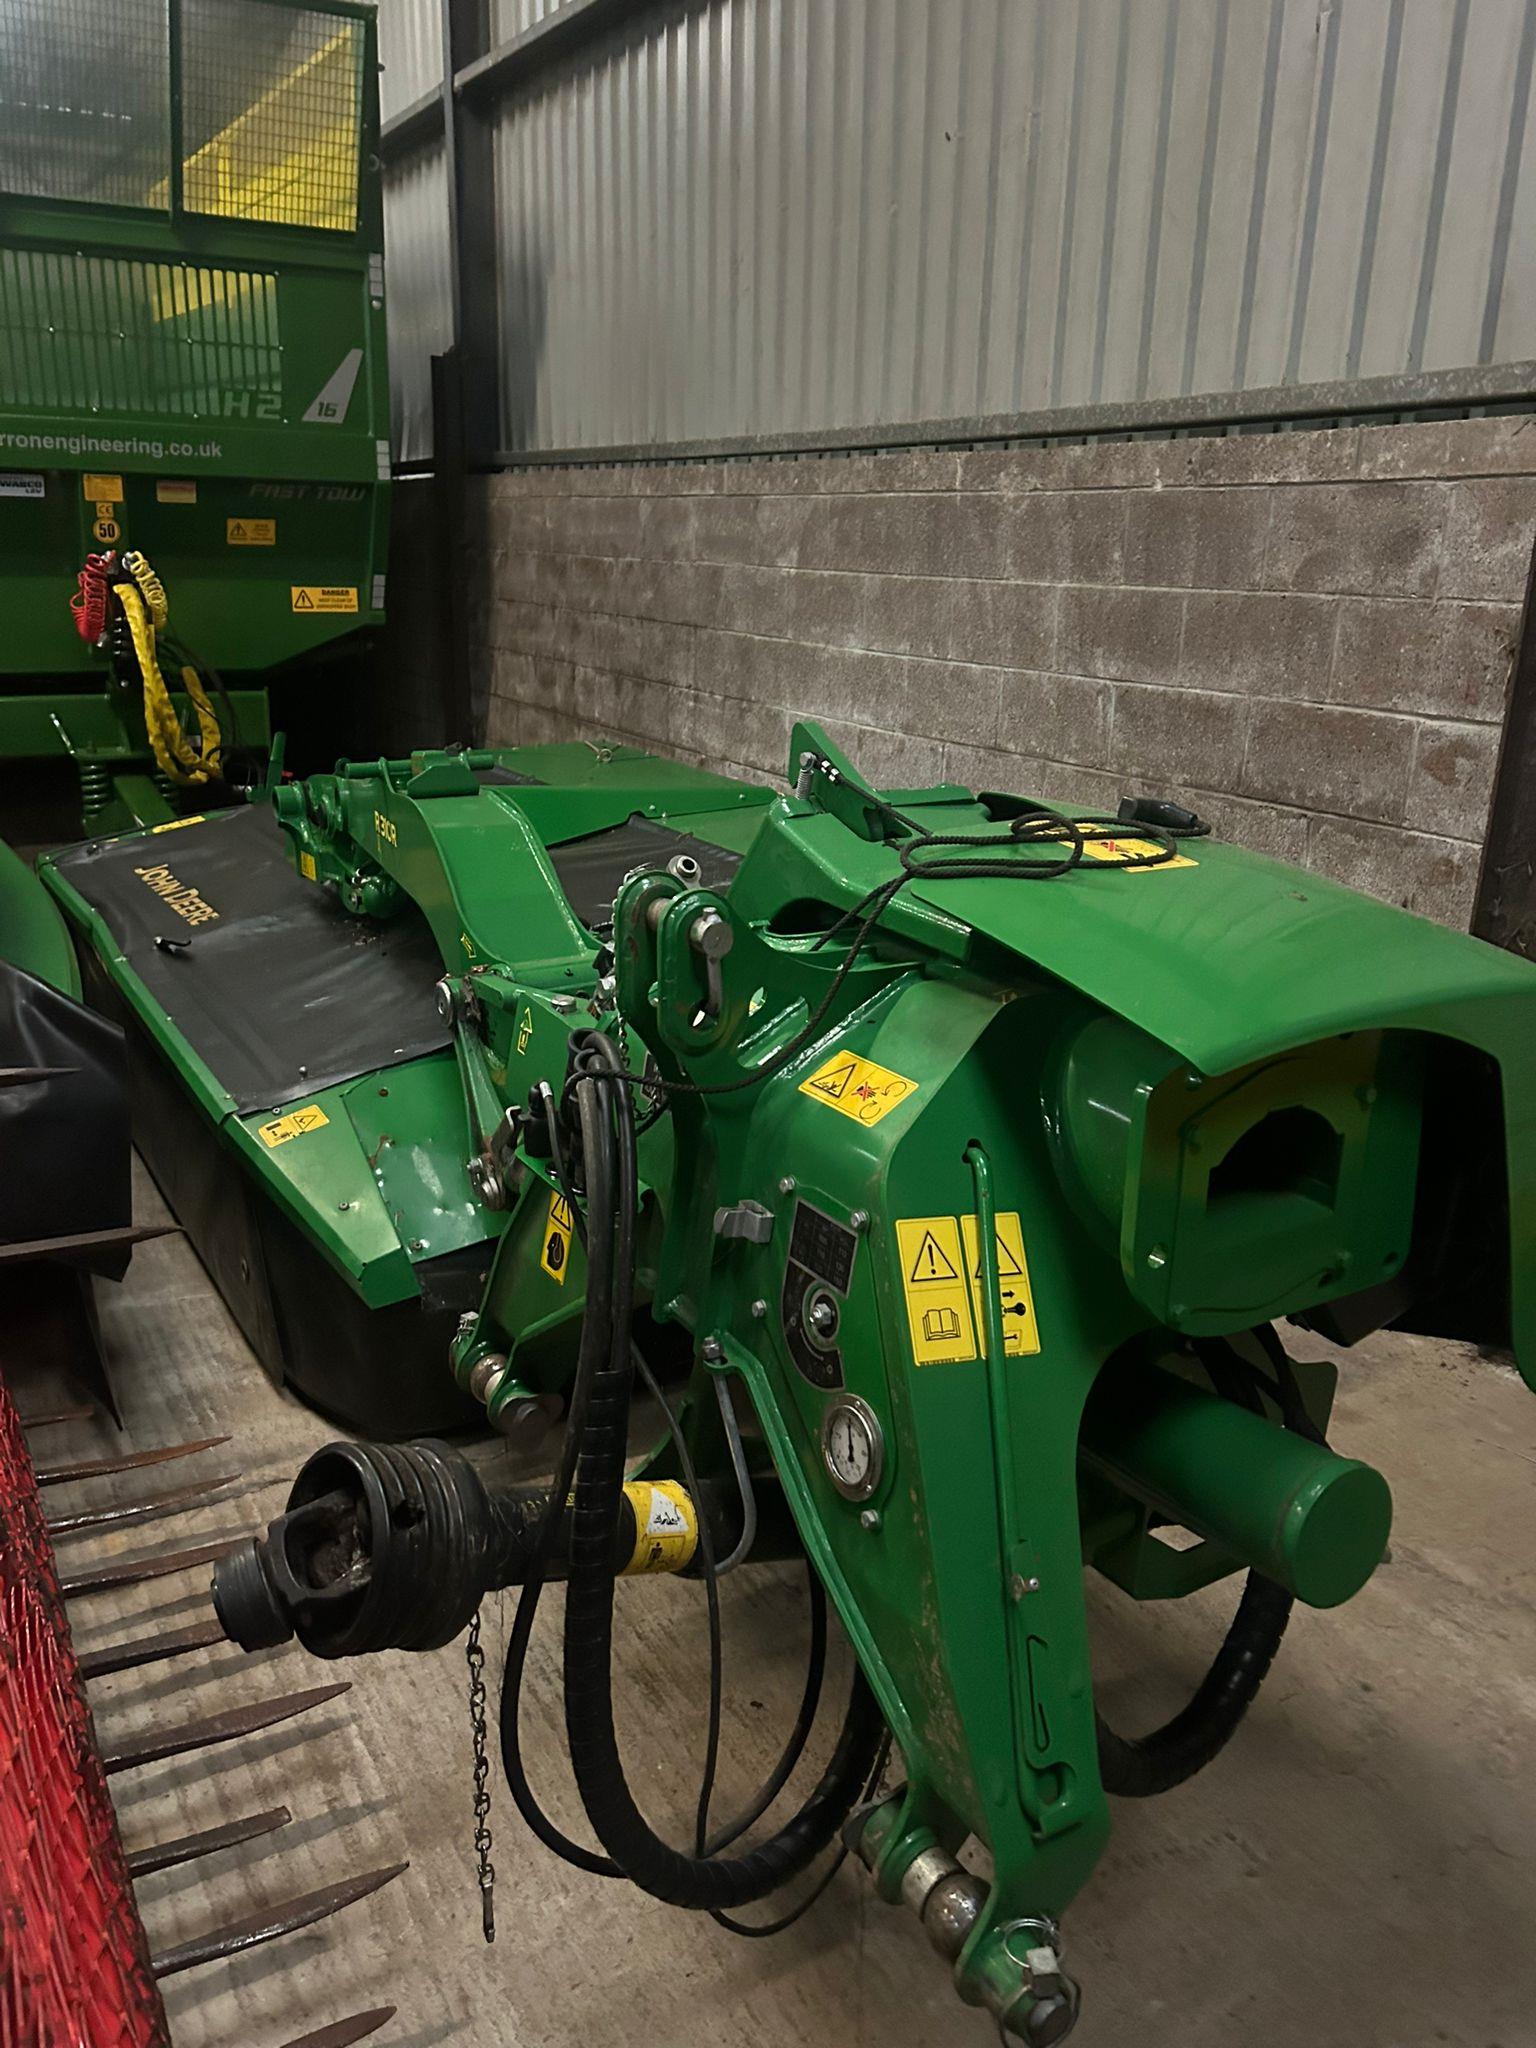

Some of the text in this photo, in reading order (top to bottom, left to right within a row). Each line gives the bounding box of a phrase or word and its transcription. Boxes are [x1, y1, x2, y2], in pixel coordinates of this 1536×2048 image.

[317, 401, 339, 418] 16
[99, 523, 116, 538] 50
[134, 864, 220, 926] JOHN DEERE
